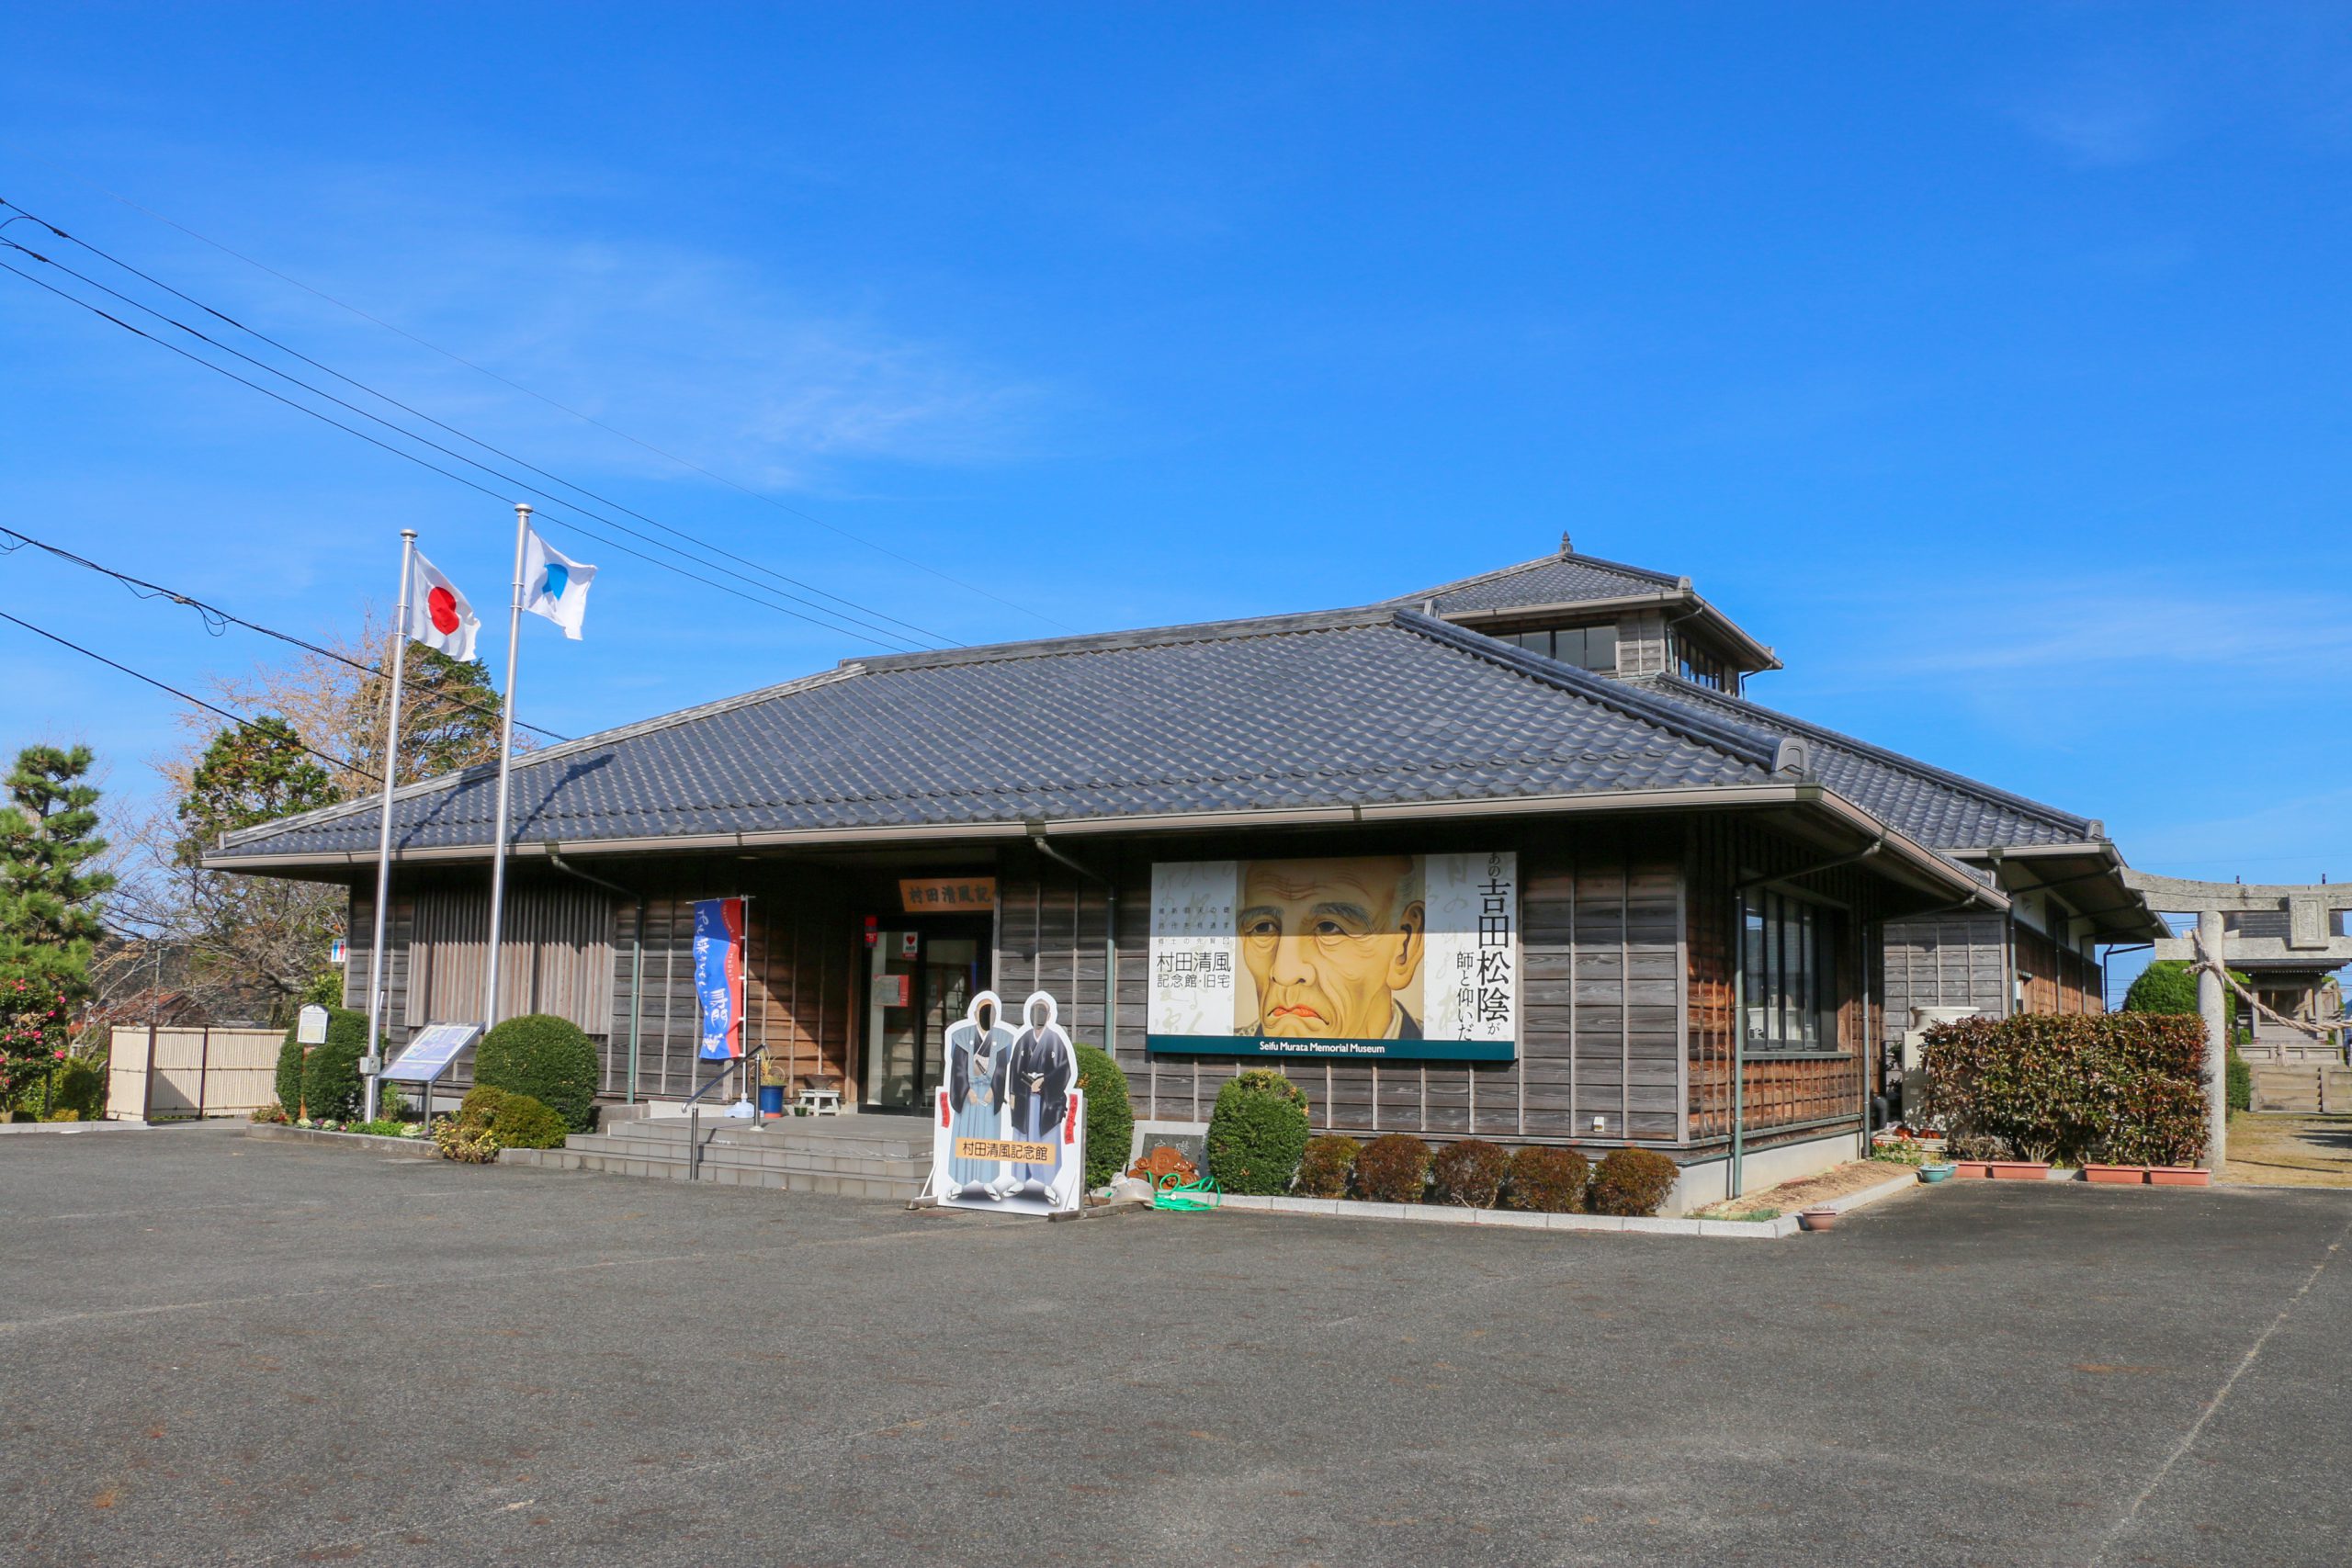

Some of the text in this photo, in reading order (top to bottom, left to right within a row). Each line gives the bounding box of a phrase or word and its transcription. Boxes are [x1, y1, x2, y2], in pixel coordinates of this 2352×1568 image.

[1157, 951, 1231, 973] 村田清風
[1456, 951, 1474, 1041] 師と仰いだ
[1259, 1041, 1385, 1054] Seifu Murata Memorial Museum
[963, 1141, 1048, 1161] 村田清風記念館
